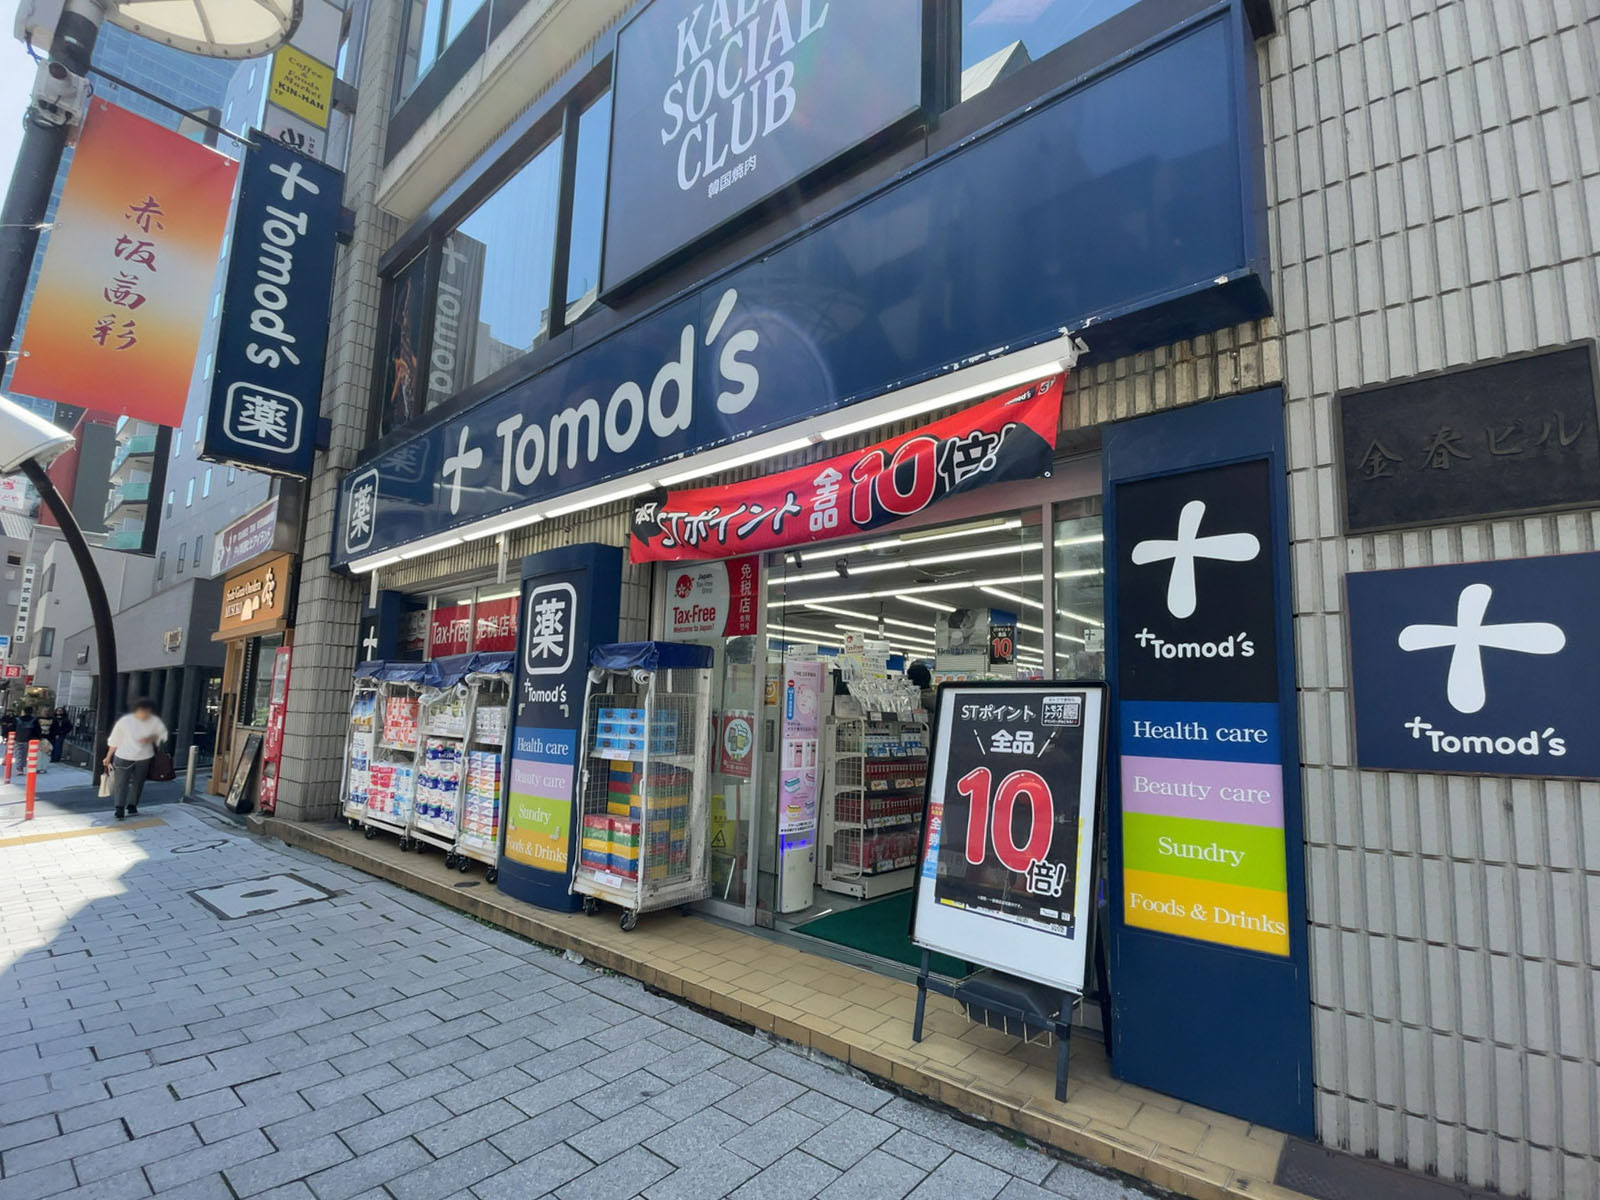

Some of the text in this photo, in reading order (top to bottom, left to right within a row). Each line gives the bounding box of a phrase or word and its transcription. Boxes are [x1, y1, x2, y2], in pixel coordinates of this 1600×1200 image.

[661, 0, 829, 145] SOCIAL
[677, 60, 797, 190] CLUB
[708, 154, 757, 199] 韓国焼肉
[247, 205, 309, 369] Tomod's
[497, 288, 760, 492] Tomod's
[239, 394, 289, 443] 薬
[1357, 410, 1585, 481] 金春ビル
[349, 483, 374, 538] 薬
[656, 491, 801, 547] STポイント
[810, 467, 843, 532] 全品
[740, 563, 752, 613] 免税店
[530, 596, 566, 659] 薬
[672, 604, 716, 625] Tax-Free
[432, 618, 471, 645] Tax-Free
[1150, 631, 1255, 659] Tomod's
[992, 637, 1012, 658] 10
[528, 683, 567, 703] Tomod's
[961, 704, 1036, 723] STポイント
[517, 737, 569, 756] Health care
[990, 729, 1035, 755] 全品
[1133, 720, 1268, 745] Health care
[1425, 727, 1567, 757] Tomod's
[514, 768, 566, 790] Beauty care
[1133, 775, 1271, 805] Beauty care
[518, 804, 552, 826] Sundry
[525, 842, 534, 856] &
[534, 842, 568, 863] Drinks
[1157, 836, 1246, 868] Sundry
[1129, 893, 1287, 936] Foods & Drinks
